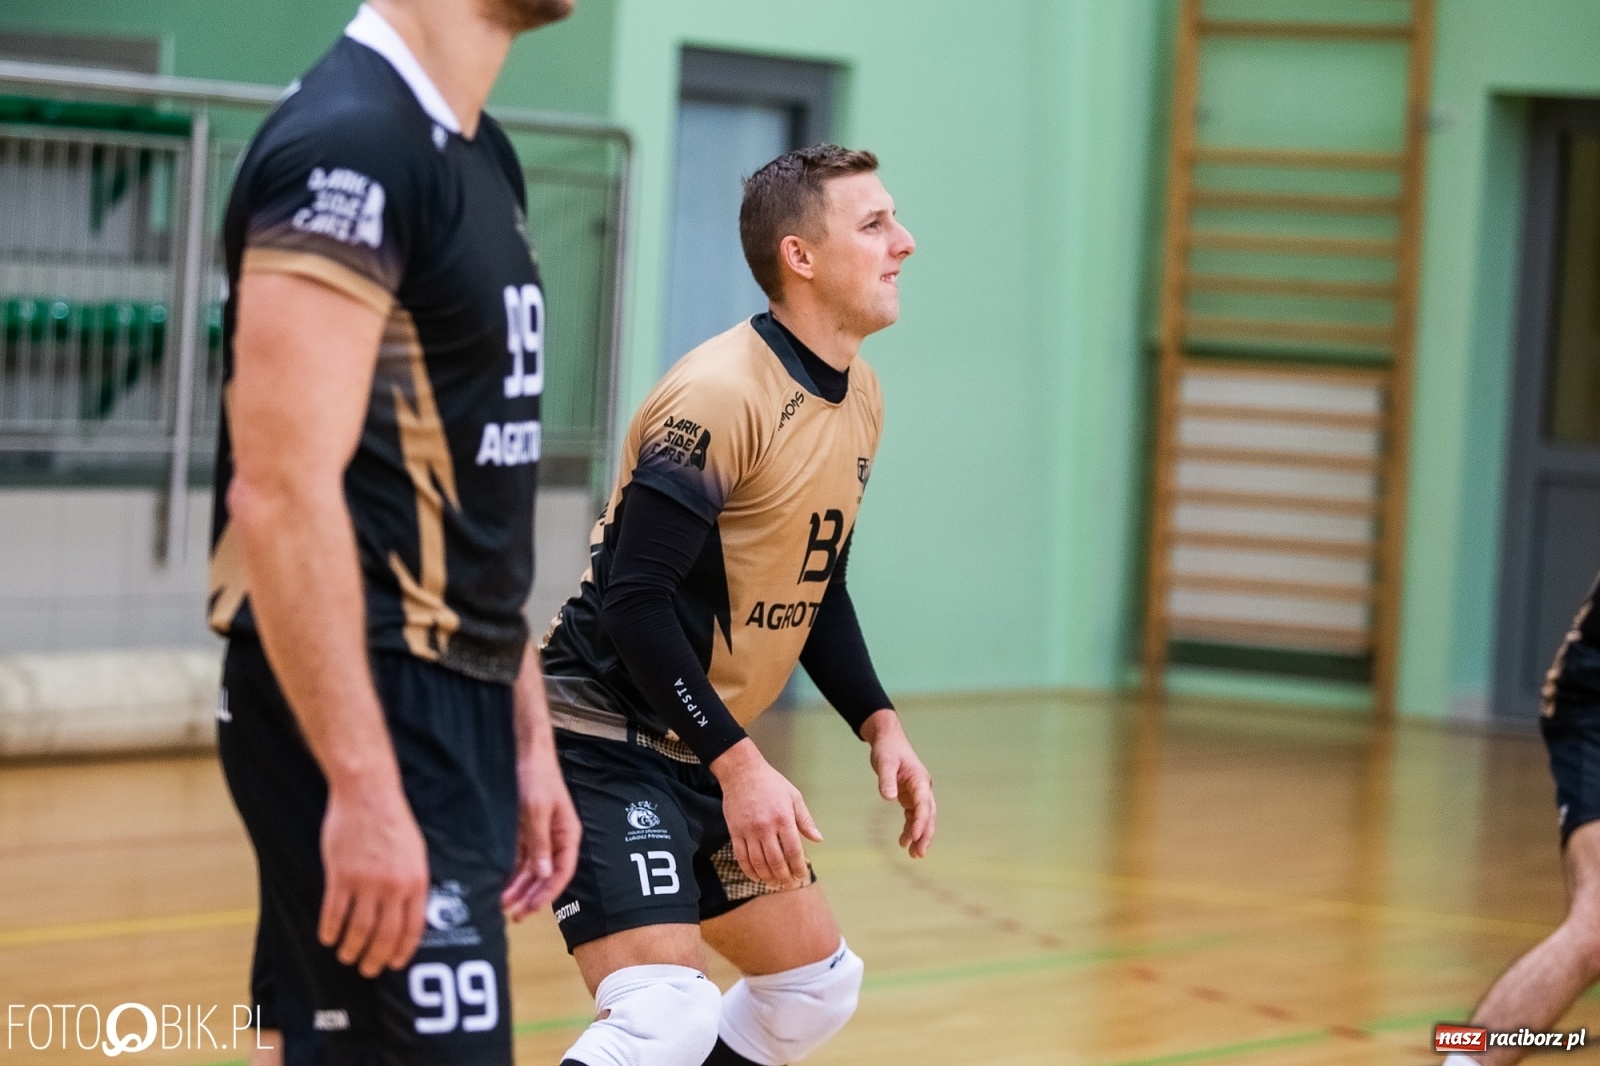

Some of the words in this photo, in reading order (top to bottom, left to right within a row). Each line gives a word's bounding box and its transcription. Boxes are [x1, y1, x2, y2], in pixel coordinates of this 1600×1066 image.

[663, 415, 702, 438] DARK
[664, 430, 695, 451] SIDE
[651, 442, 685, 465] CARS
[797, 509, 844, 585] 13
[674, 677, 709, 728] KIPSTA
[630, 850, 681, 896] 13
[408, 959, 499, 1034] 99
